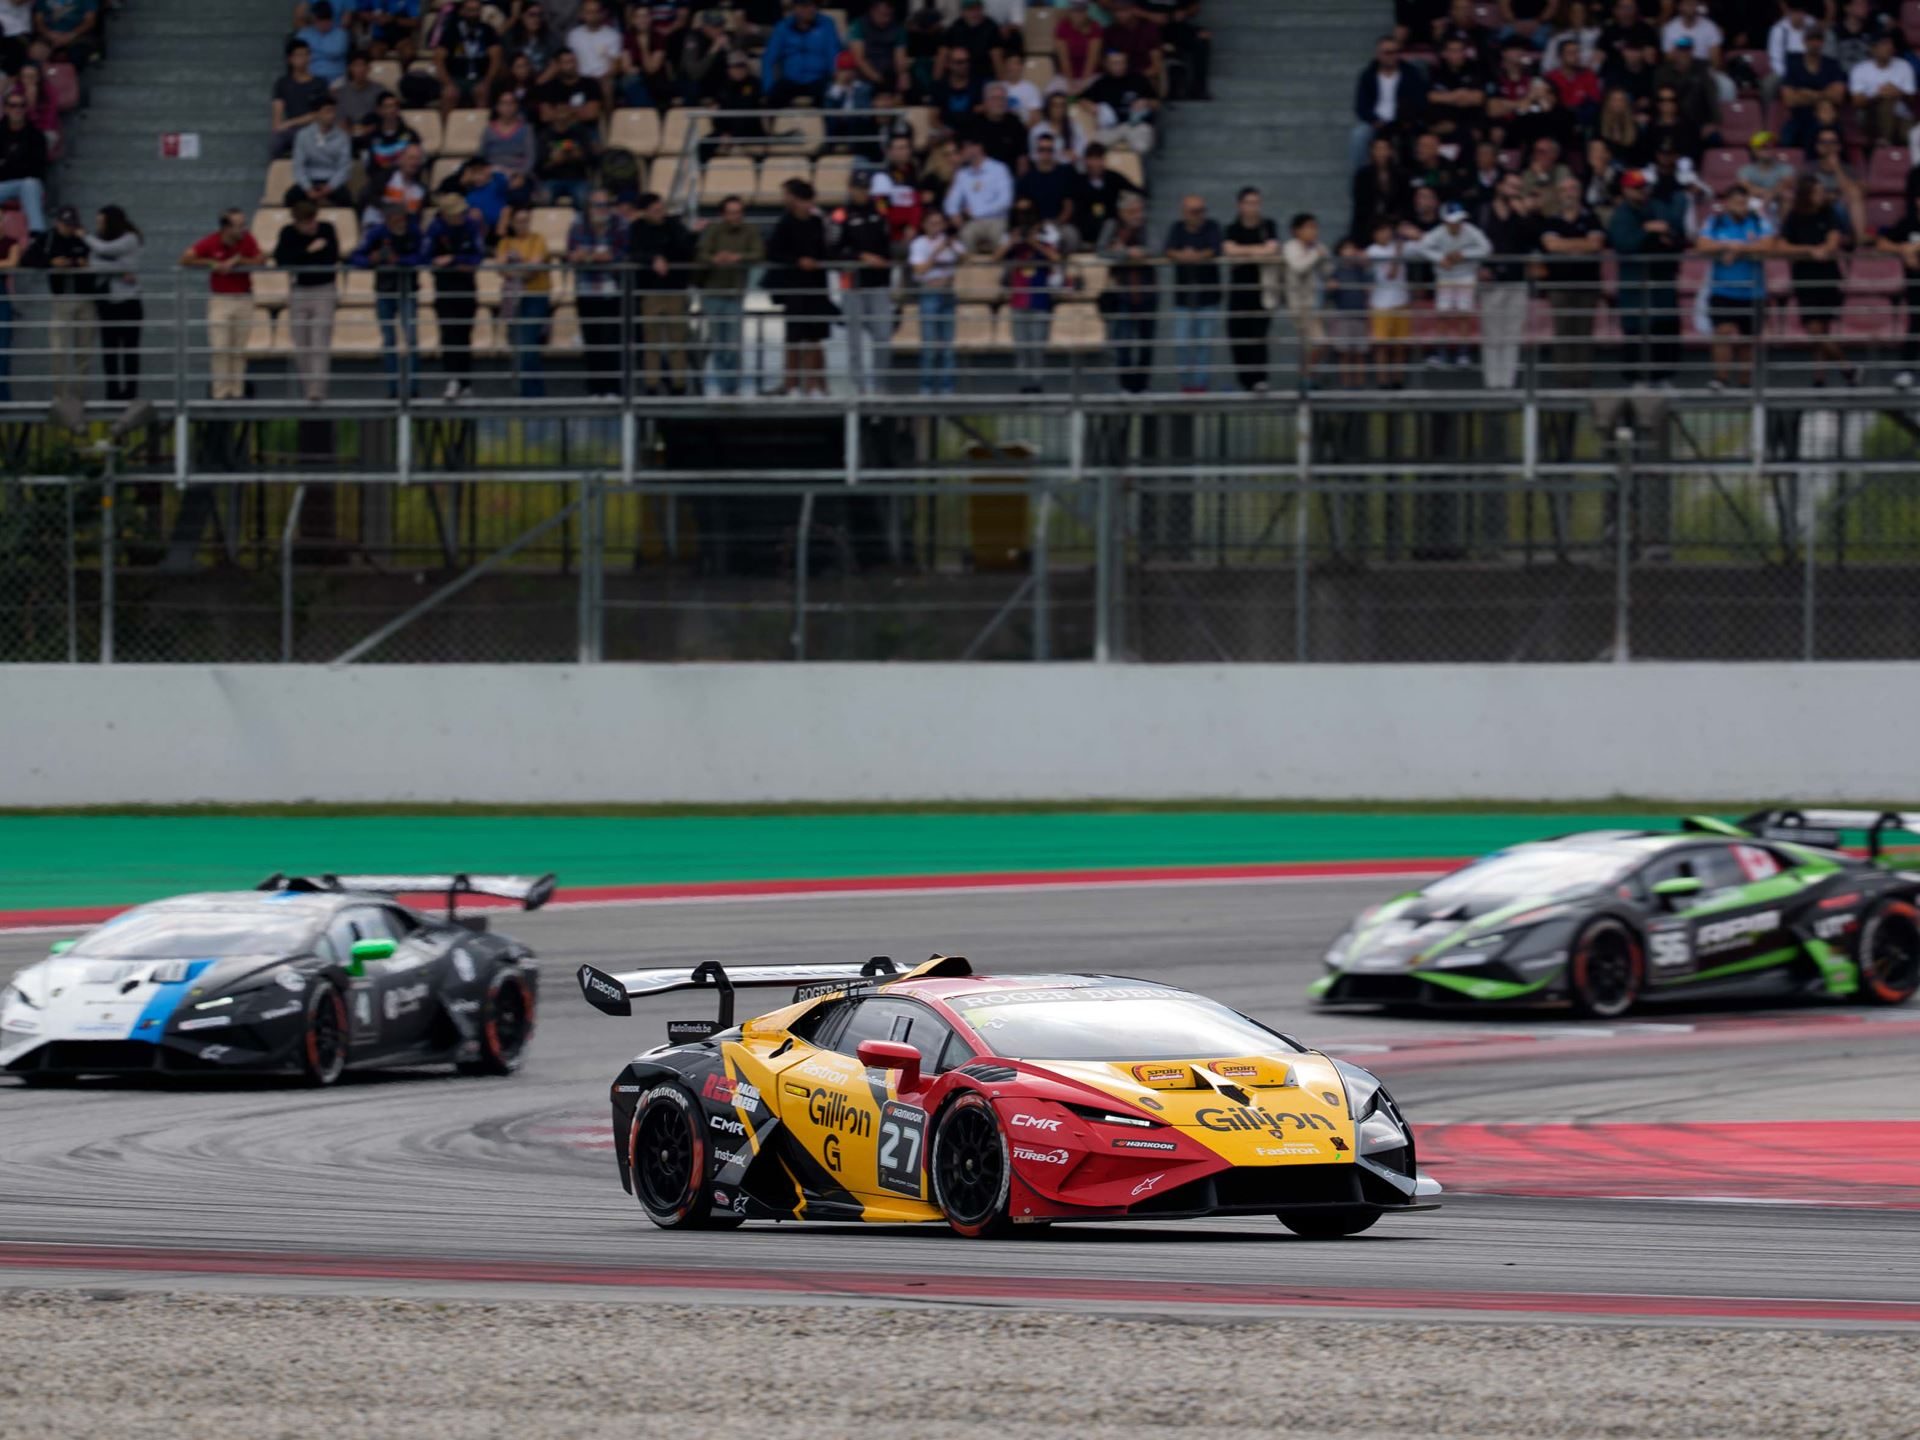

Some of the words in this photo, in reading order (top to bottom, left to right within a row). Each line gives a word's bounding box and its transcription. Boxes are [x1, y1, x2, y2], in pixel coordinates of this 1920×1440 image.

[592, 977, 621, 1000] macron
[962, 990, 1079, 1007] ROGER
[808, 1087, 871, 1138] Gillion
[1011, 1113, 1063, 1132] CMR
[710, 1115, 745, 1136] CMR
[823, 1133, 842, 1172] G
[879, 1121, 921, 1174] 27
[1256, 1146, 1321, 1156] Fastron
